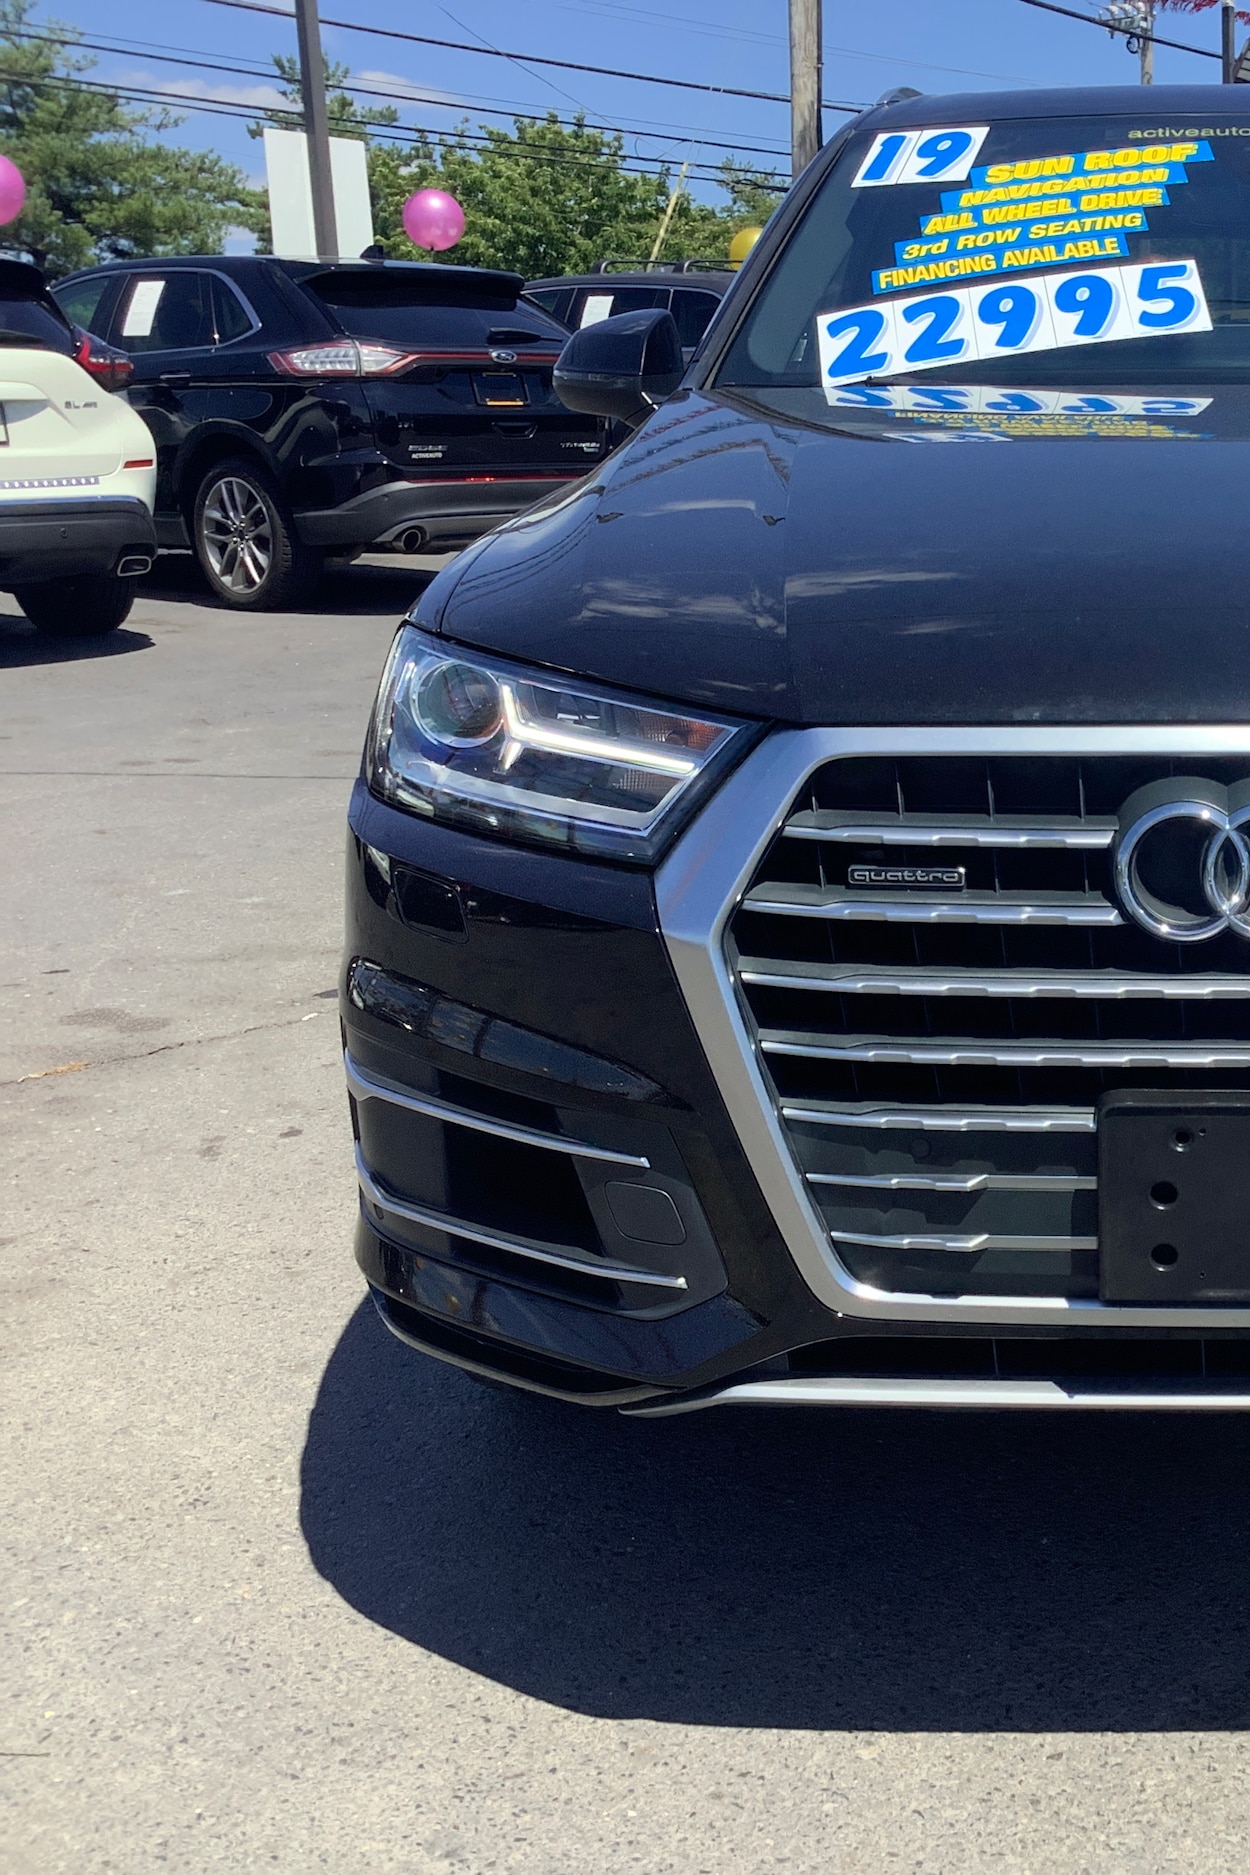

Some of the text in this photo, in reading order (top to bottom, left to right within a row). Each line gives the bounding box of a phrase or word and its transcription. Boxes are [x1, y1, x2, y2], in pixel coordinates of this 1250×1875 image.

[861, 131, 974, 182] 19
[985, 143, 1198, 185] SUN ROOF
[922, 187, 1163, 236] ALL WHEEL DRIVE
[959, 168, 1170, 207] NAVIGATION
[902, 213, 1142, 260] 3rd ROW SEATING
[879, 237, 1121, 290] FINANCING AVAILABLE
[826, 264, 1197, 380] 22995
[853, 870, 959, 882] quattro
